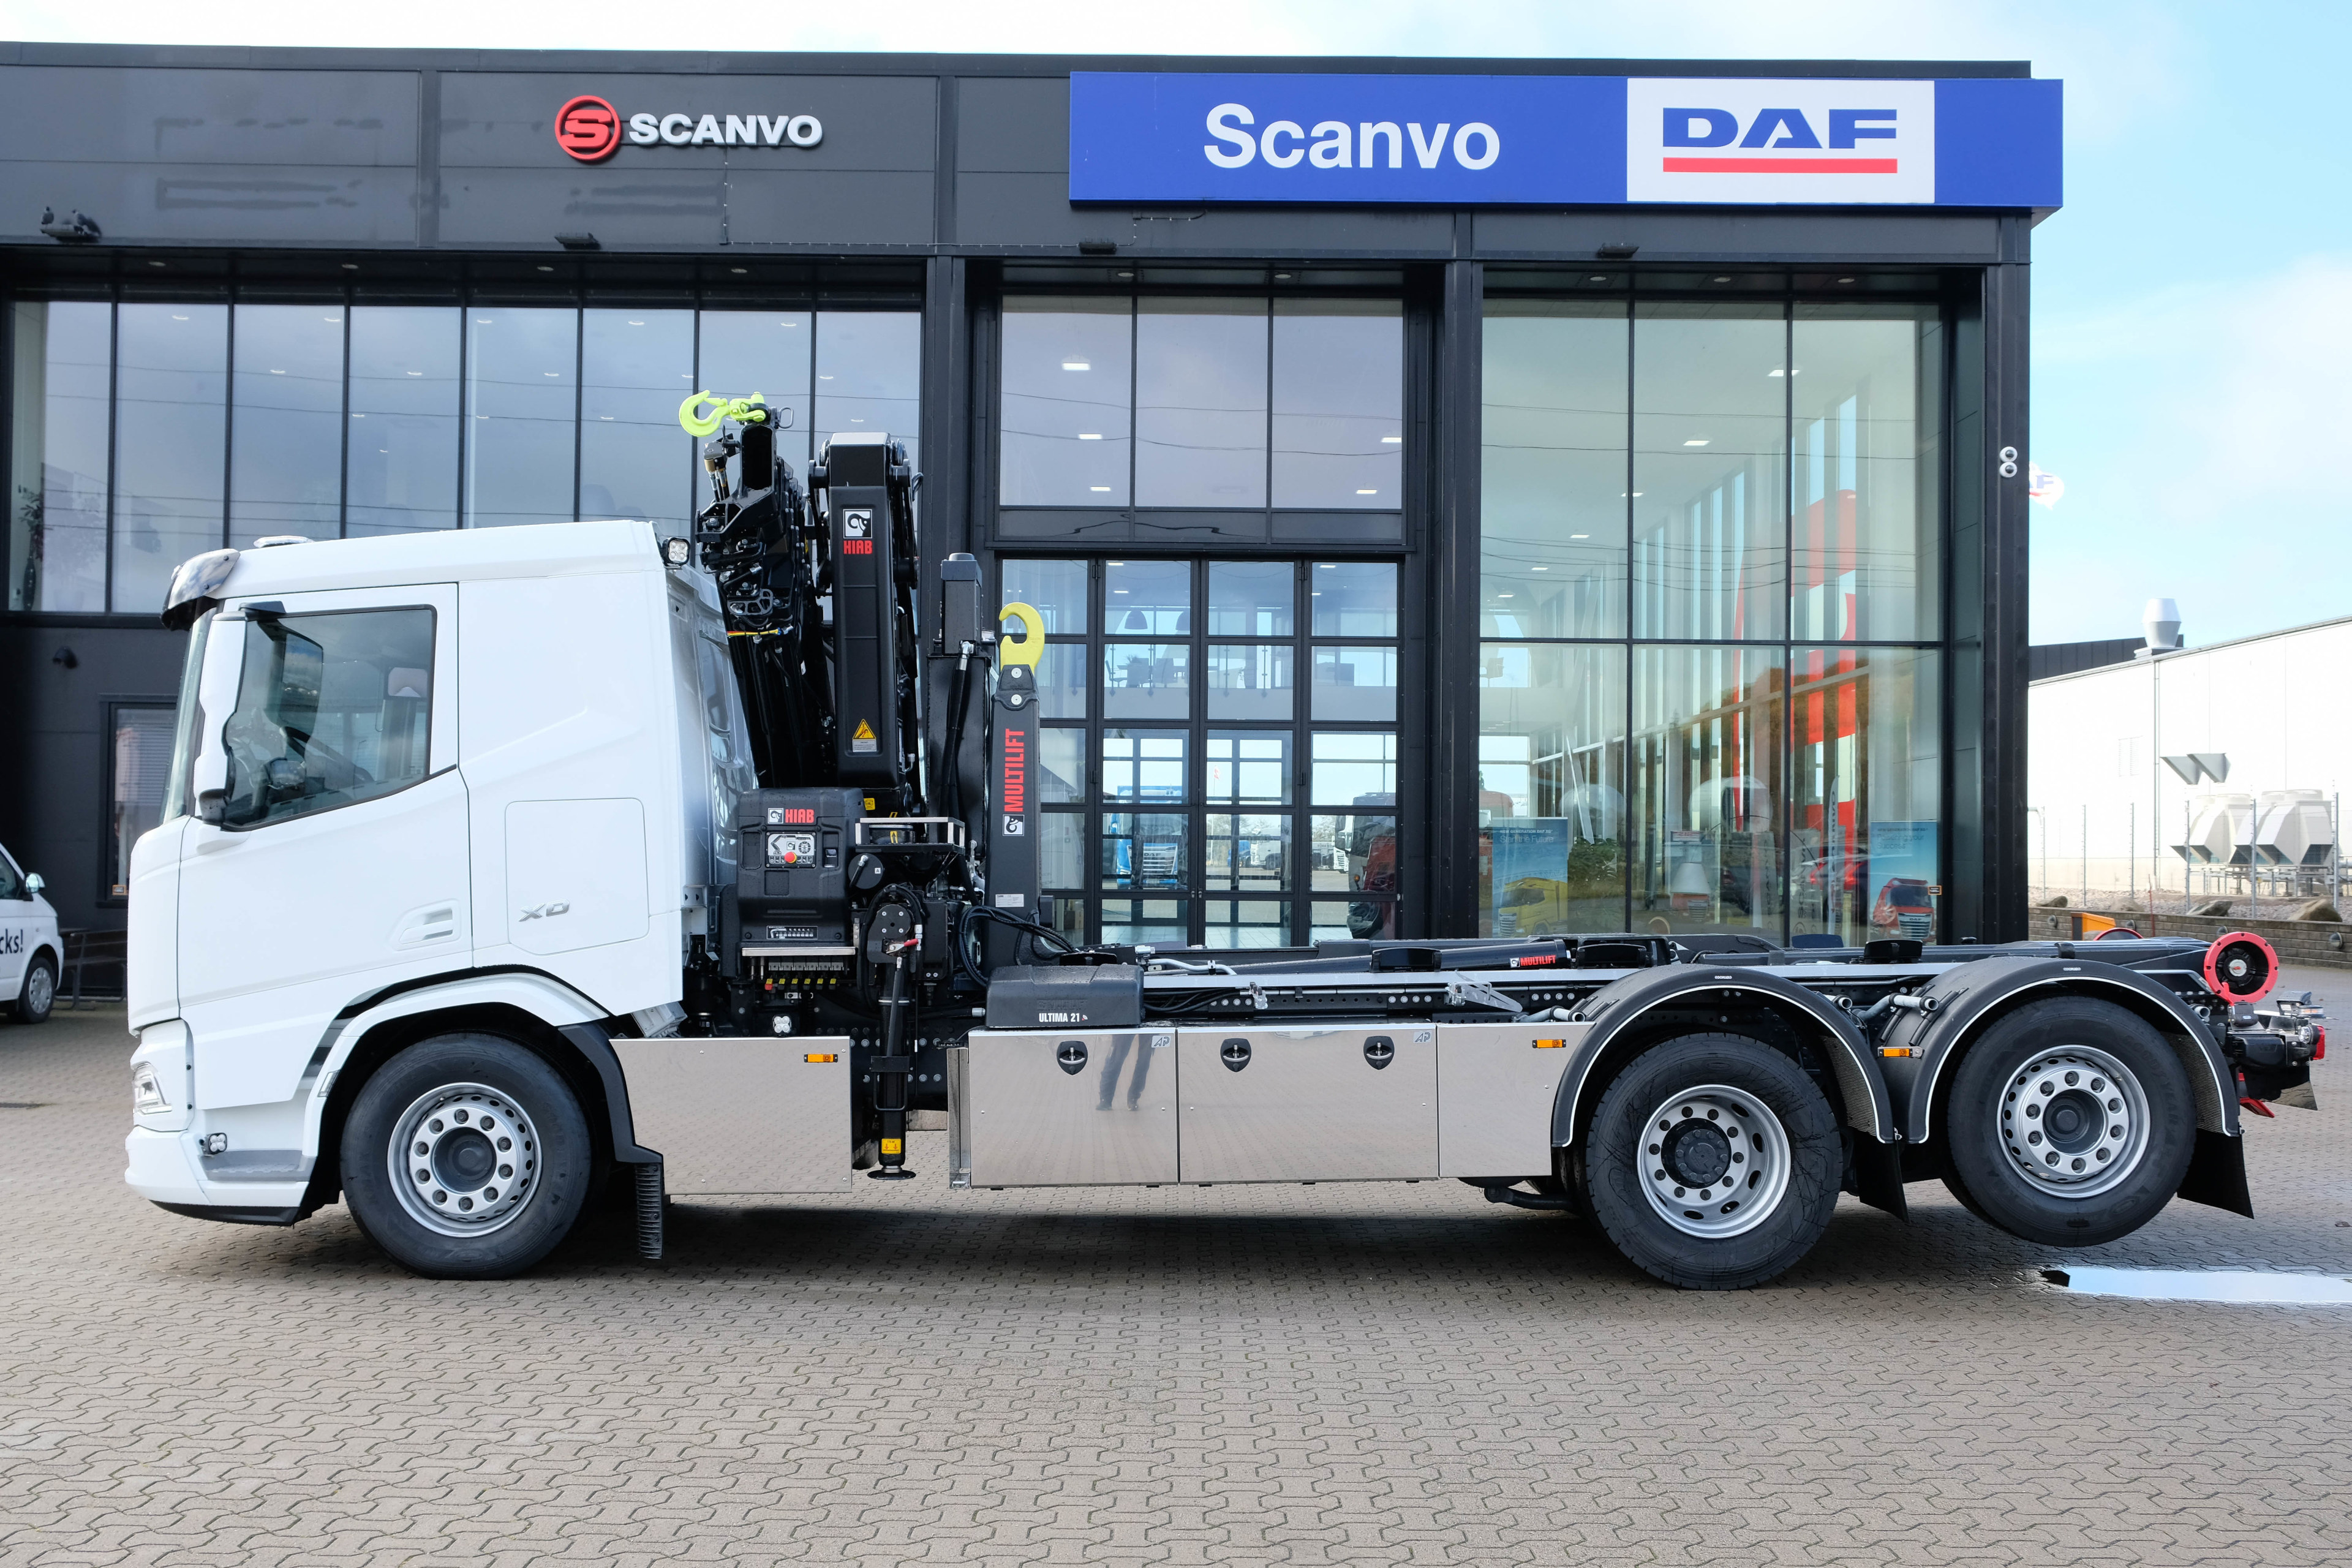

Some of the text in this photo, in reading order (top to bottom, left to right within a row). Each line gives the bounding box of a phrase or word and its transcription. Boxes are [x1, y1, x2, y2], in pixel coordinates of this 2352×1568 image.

[628, 113, 823, 148] SCANVO
[1203, 102, 1501, 170] Scanvo
[1662, 107, 1898, 149] DAF
[843, 540, 873, 554] HIAB
[1003, 728, 1025, 812] MULTILIFT
[785, 809, 815, 823] HIAB
[518, 899, 571, 922] XD
[1520, 954, 1556, 967] MULTILIFT
[1039, 1012, 1080, 1023] ULTIMA 21
